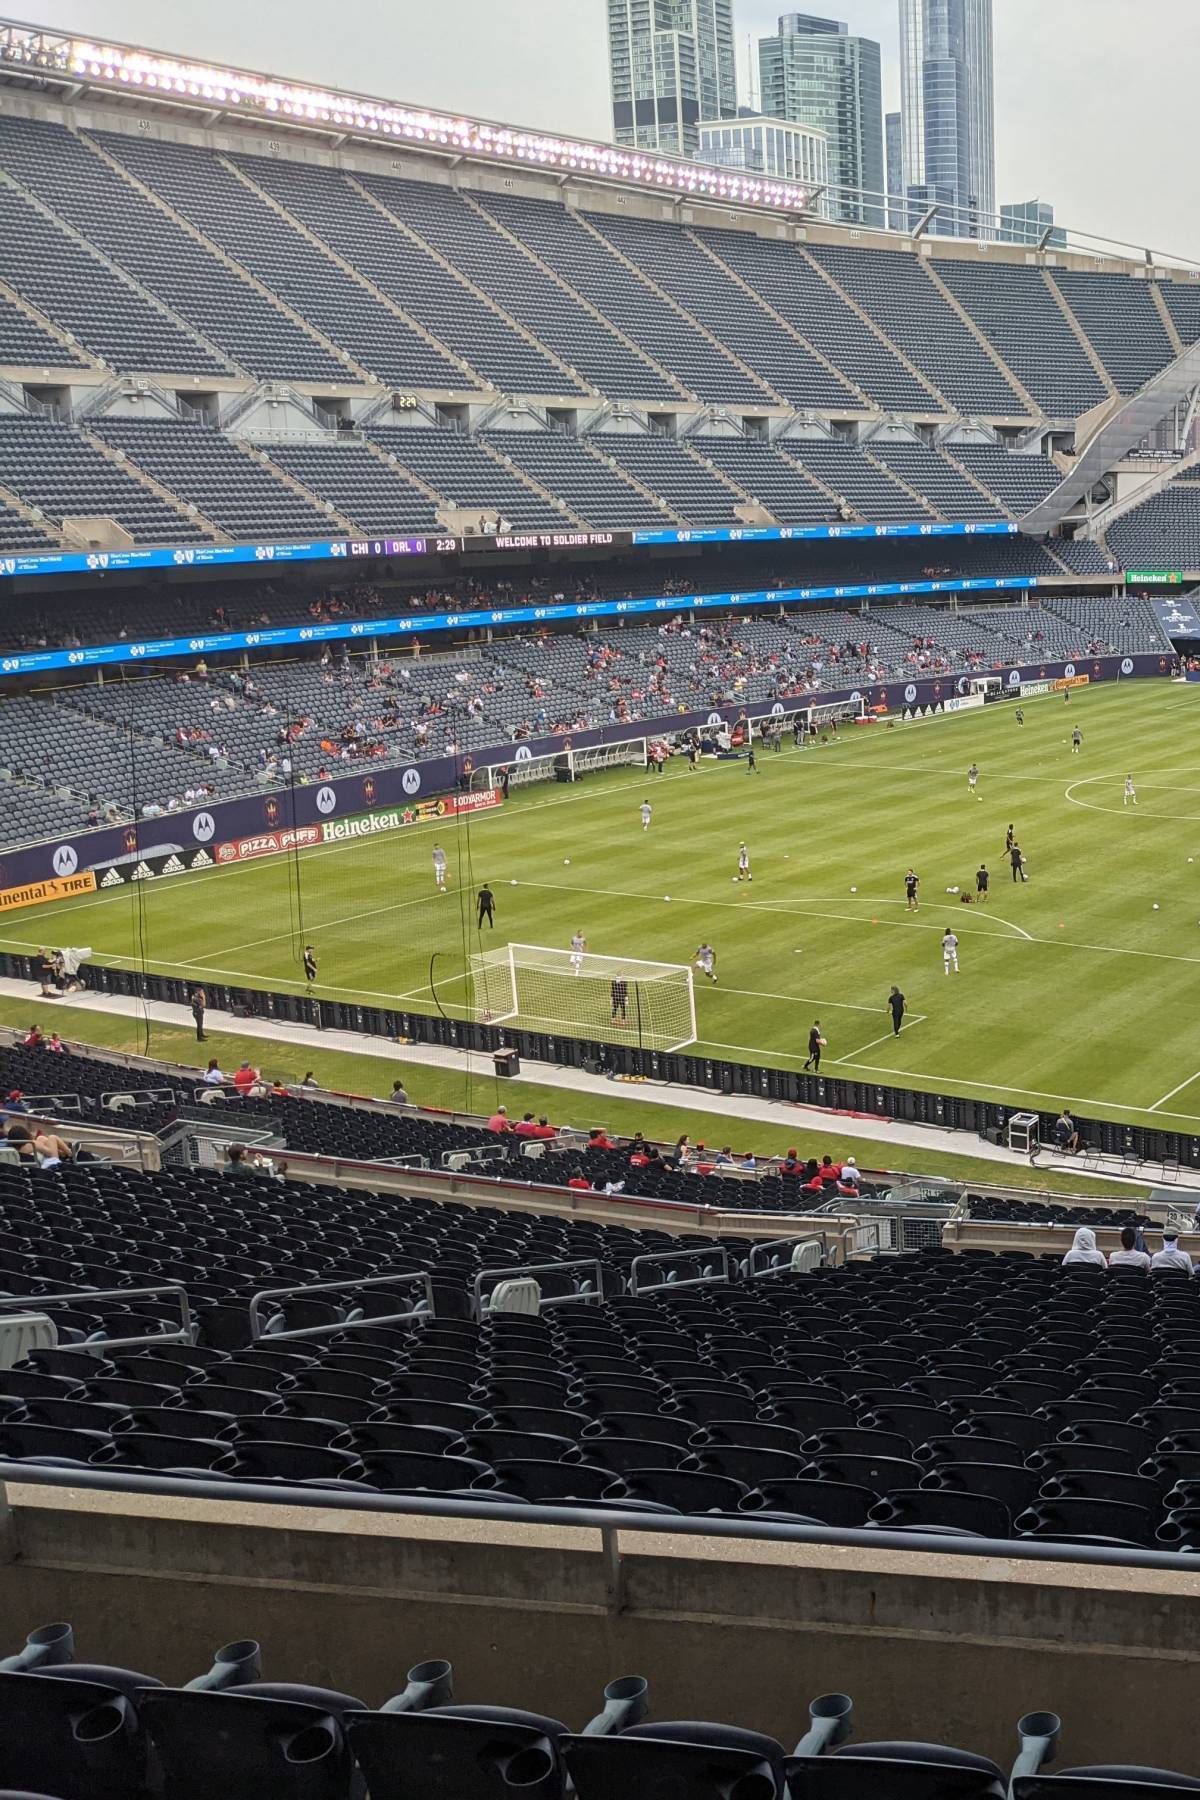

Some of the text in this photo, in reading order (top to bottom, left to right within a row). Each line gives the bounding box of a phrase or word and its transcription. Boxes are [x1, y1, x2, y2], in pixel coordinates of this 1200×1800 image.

[400, 396, 416, 407] 2:29
[496, 533, 613, 548] WELCOME TO SOLDIER FIELD
[351, 539, 456, 554] CHI 0 ORL 0 2:29
[1131, 573, 1167, 582] Heineken
[322, 812, 400, 841] Heineken
[240, 837, 277, 856] PIZZA
[281, 829, 318, 846] PUFF
[191, 858, 213, 868] adidas
[163, 864, 186, 874] adidas
[131, 871, 155, 881] adidas
[61, 877, 92, 892] TIRE
[101, 877, 125, 888] adidas
